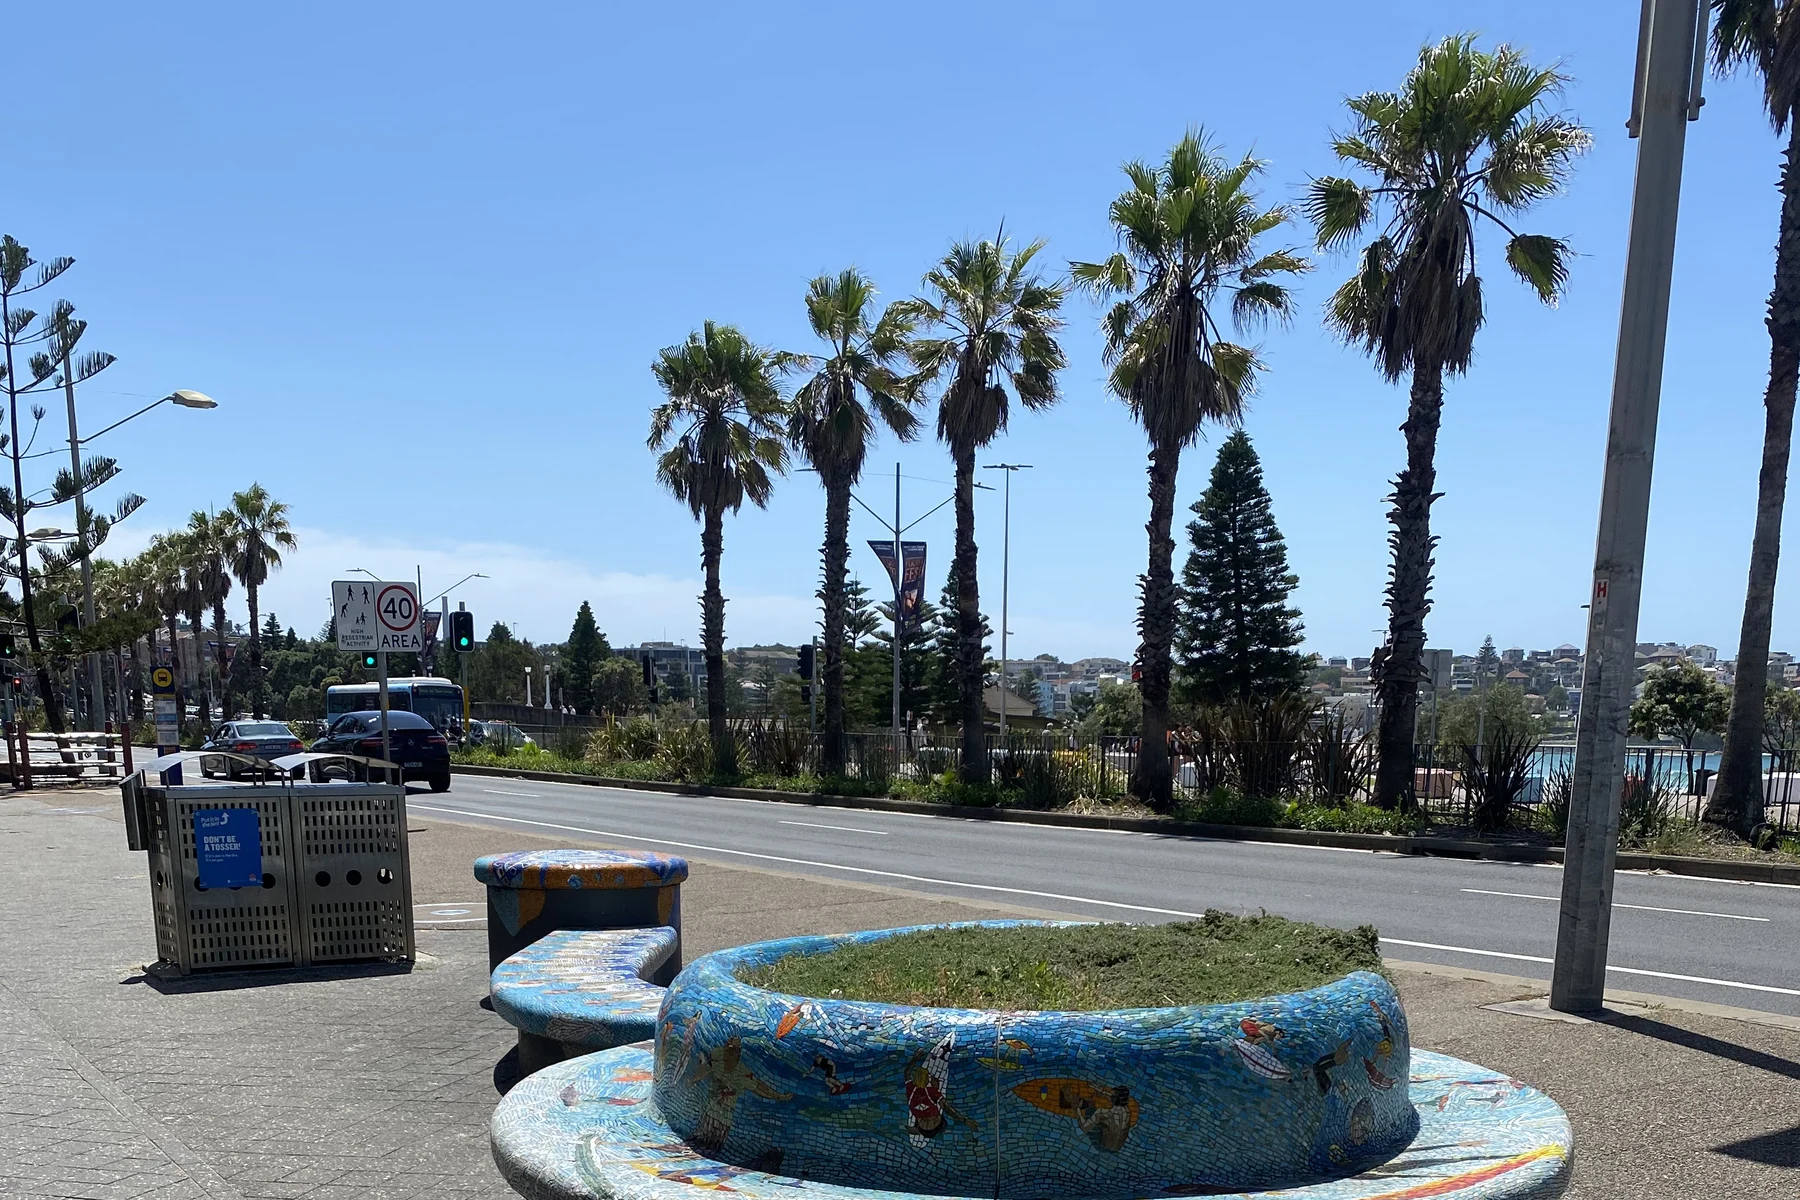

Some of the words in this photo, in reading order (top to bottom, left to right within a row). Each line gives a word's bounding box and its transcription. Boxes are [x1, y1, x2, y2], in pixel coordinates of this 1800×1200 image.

[1596, 581, 1608, 598] H
[383, 597, 412, 620] 40
[381, 634, 421, 648] AREA
[203, 835, 225, 844] DON'T
[226, 835, 236, 843] BE
[204, 843, 210, 851] A
[211, 842, 241, 851] TOSSER!
